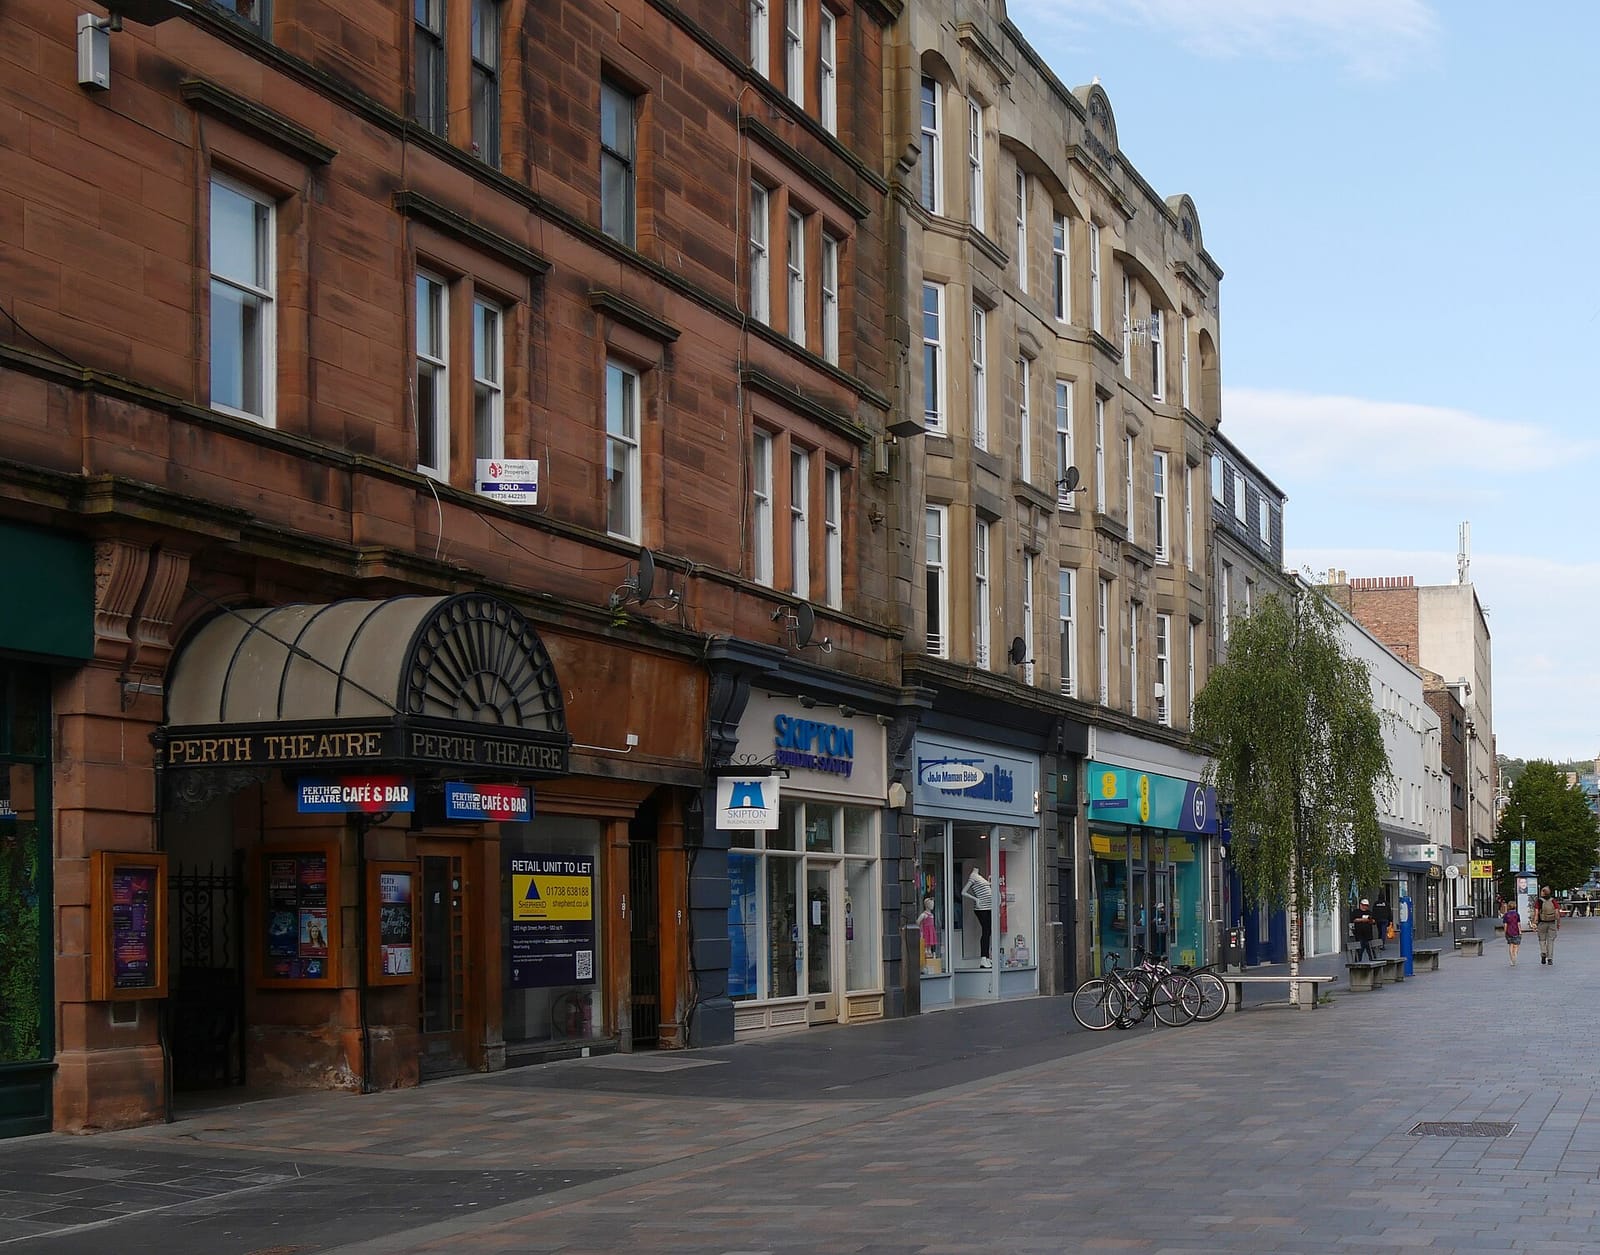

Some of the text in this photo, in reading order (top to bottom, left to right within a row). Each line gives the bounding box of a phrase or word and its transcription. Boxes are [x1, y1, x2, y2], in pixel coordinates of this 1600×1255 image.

[775, 714, 854, 758] SKIPTON
[168, 732, 382, 764] PERTH THEATRE
[412, 732, 562, 770] PERTH THEATRE
[928, 770, 978, 782] JoJo Maman Bébé
[303, 783, 409, 802] PERTH CAFÉ & BAR
[303, 794, 341, 804] THEATRE
[452, 792, 527, 813] PERTH CAFÉ & BAR
[452, 801, 481, 810] THEATRE
[1195, 800, 1204, 817] BT
[727, 810, 767, 819] SKIPTON
[512, 860, 592, 873] RETAIL UNIT TO LET
[546, 886, 566, 897] 01738
[518, 901, 547, 909] SHEPHERD
[552, 900, 589, 908] shepherd.co.uk
